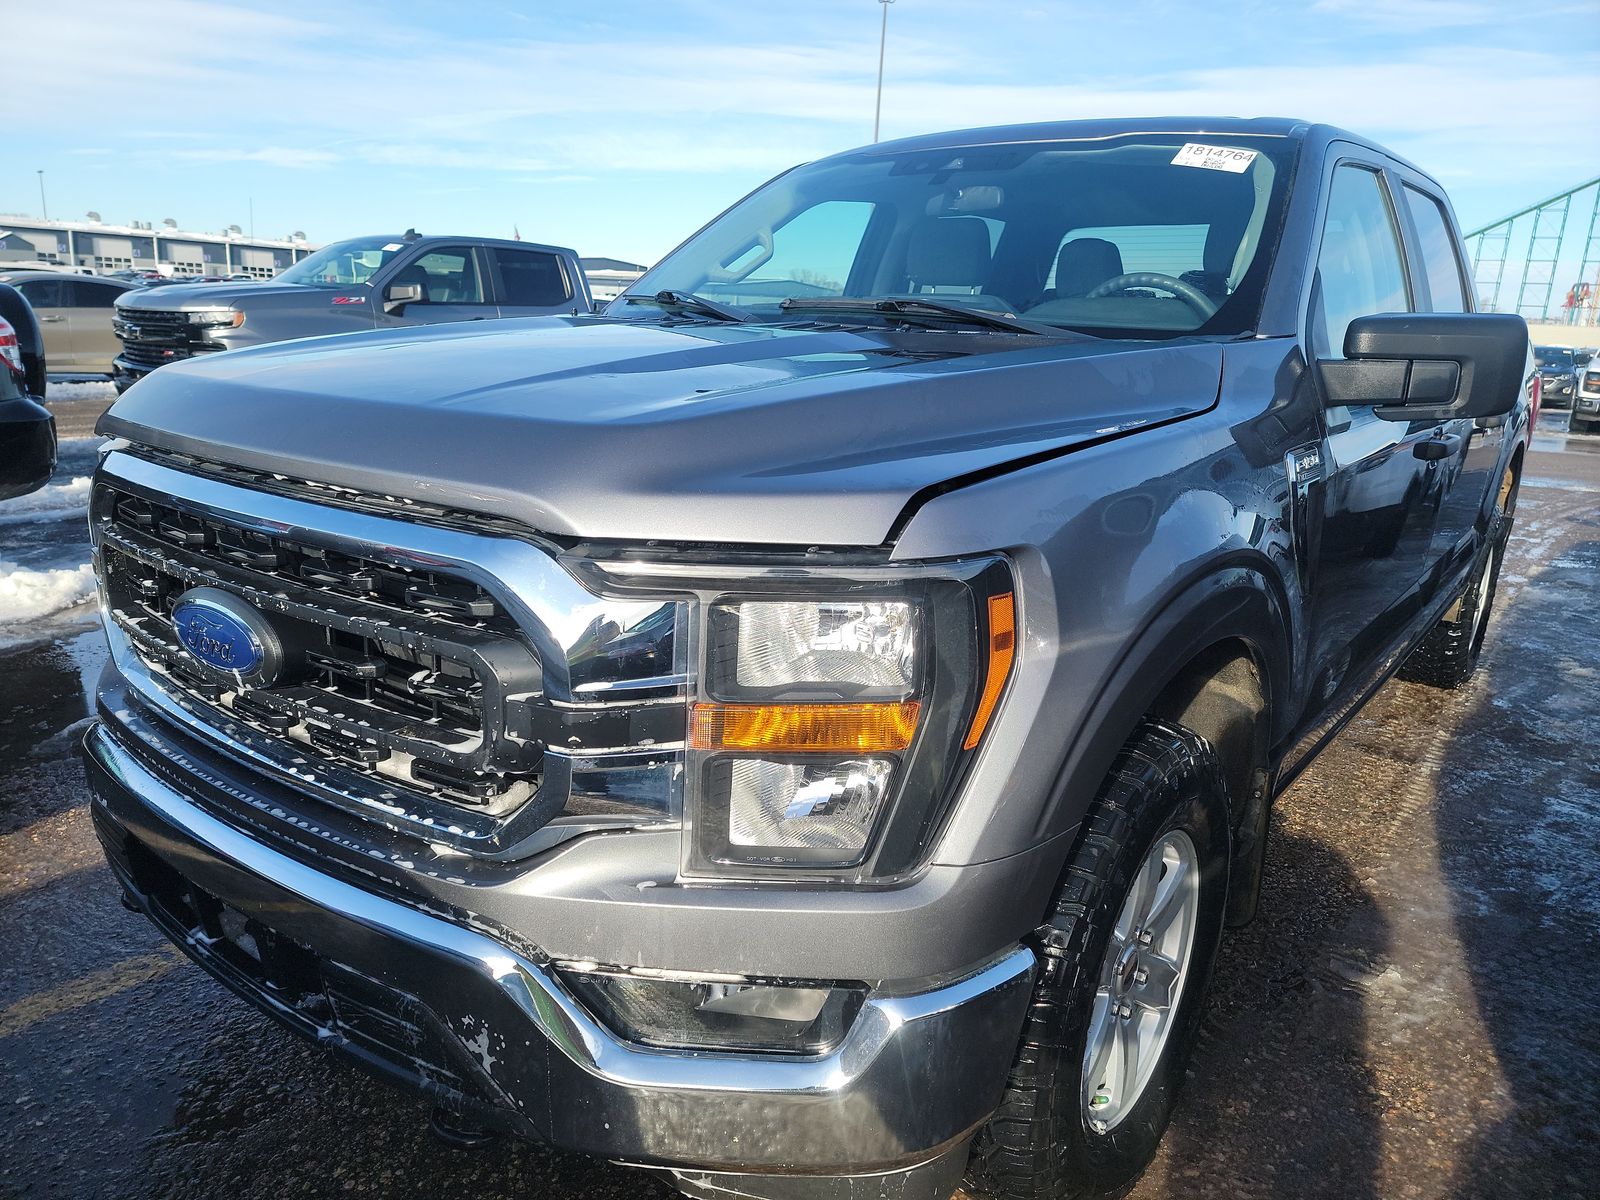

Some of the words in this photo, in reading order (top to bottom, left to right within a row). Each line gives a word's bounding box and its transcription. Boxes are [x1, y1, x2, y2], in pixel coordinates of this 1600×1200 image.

[1186, 145, 1254, 162] 1814764
[332, 296, 366, 305] Z71
[187, 613, 236, 664] Ford
